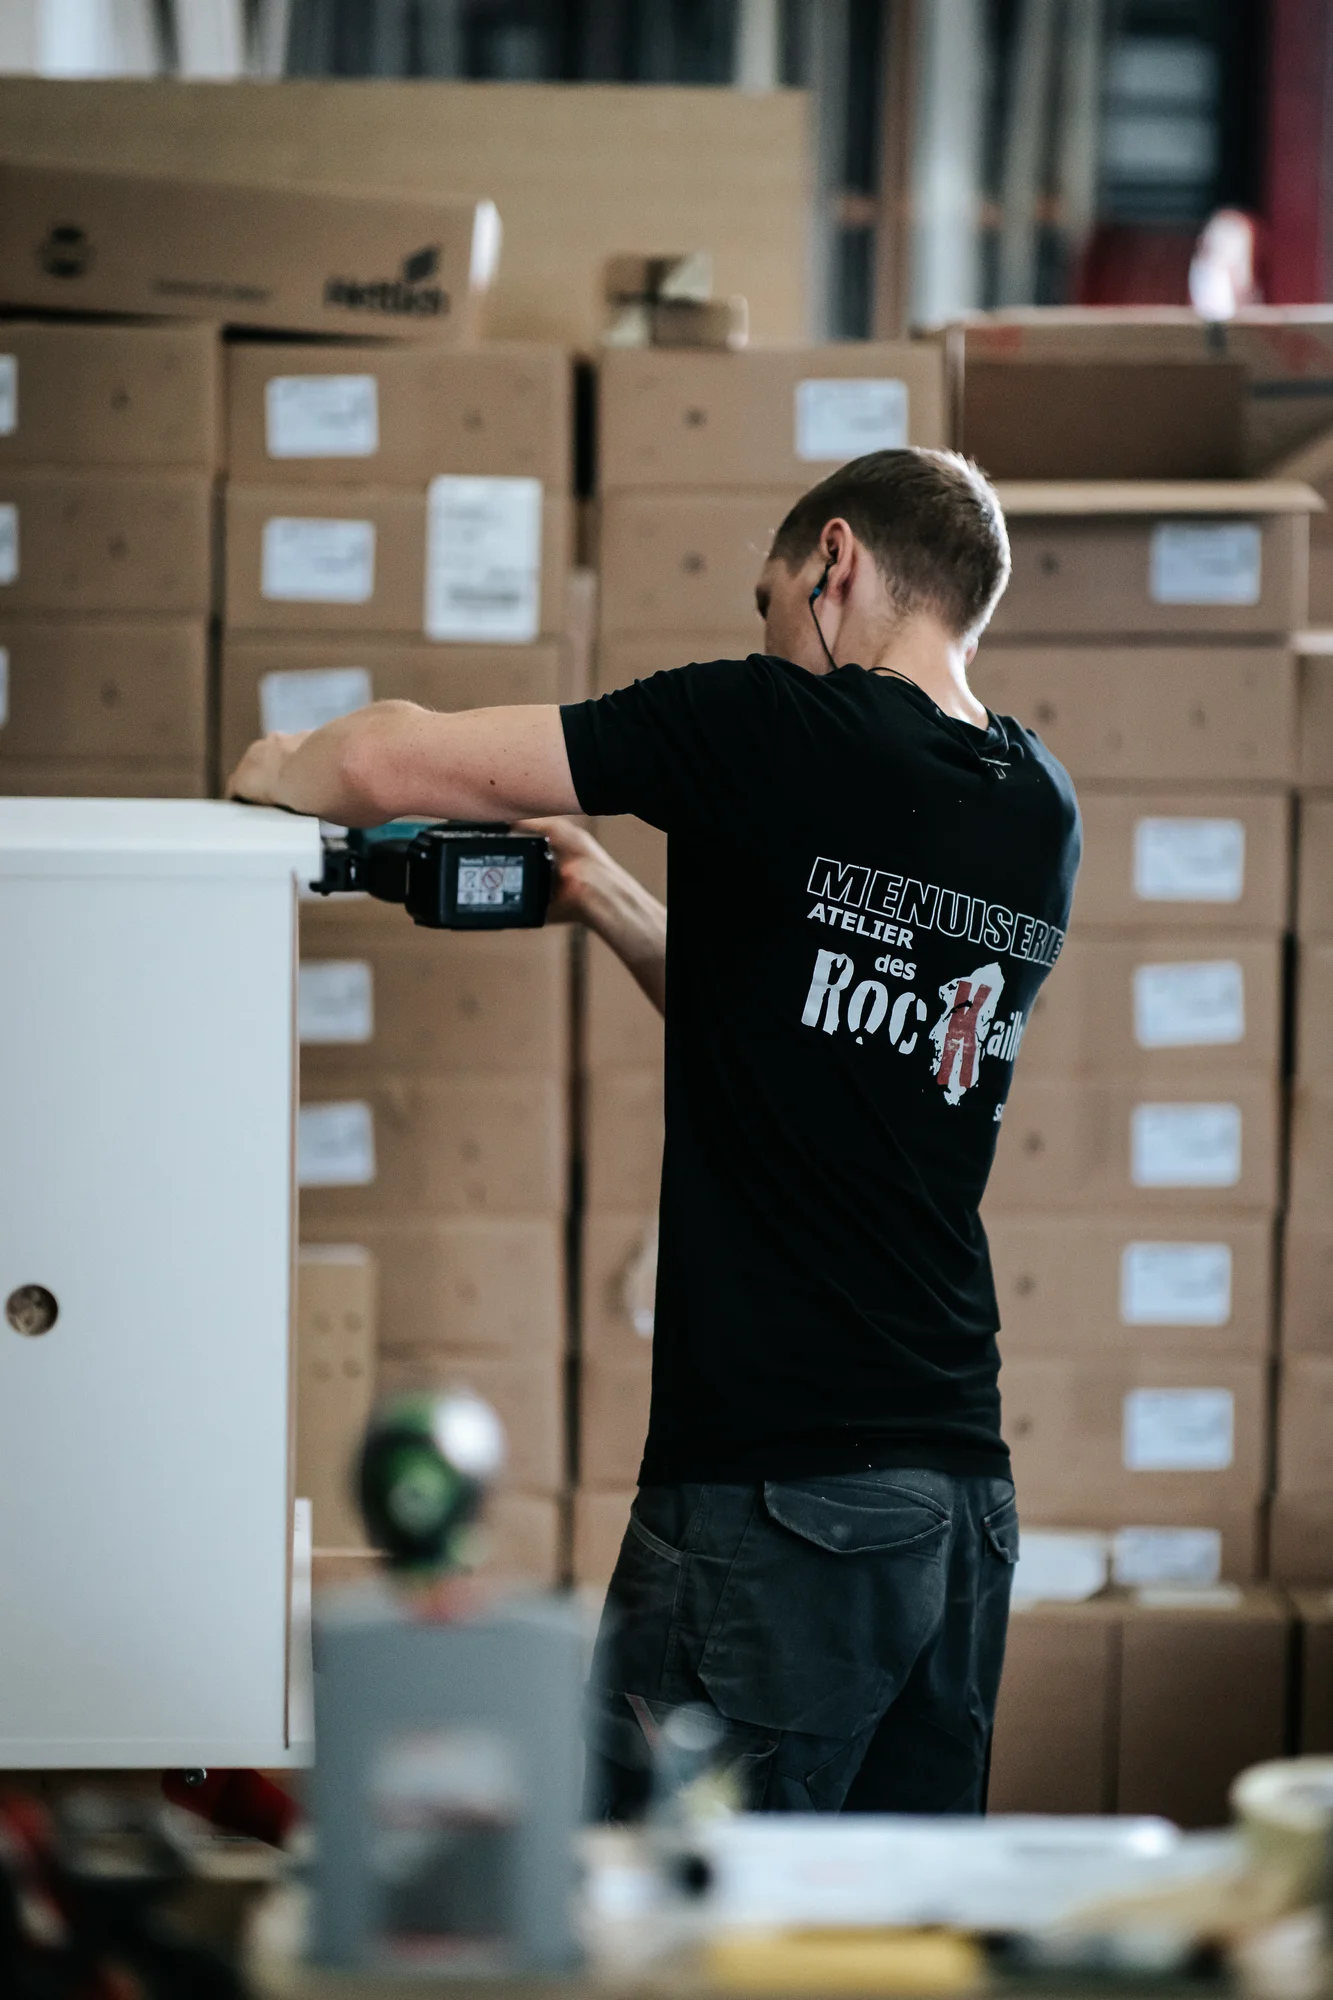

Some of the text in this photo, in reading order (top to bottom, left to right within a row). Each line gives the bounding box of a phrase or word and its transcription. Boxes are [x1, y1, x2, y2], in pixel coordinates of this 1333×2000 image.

[807, 856, 1065, 966] MENUISERIE
[807, 902, 913, 949] ATELIER
[874, 954, 917, 980] des
